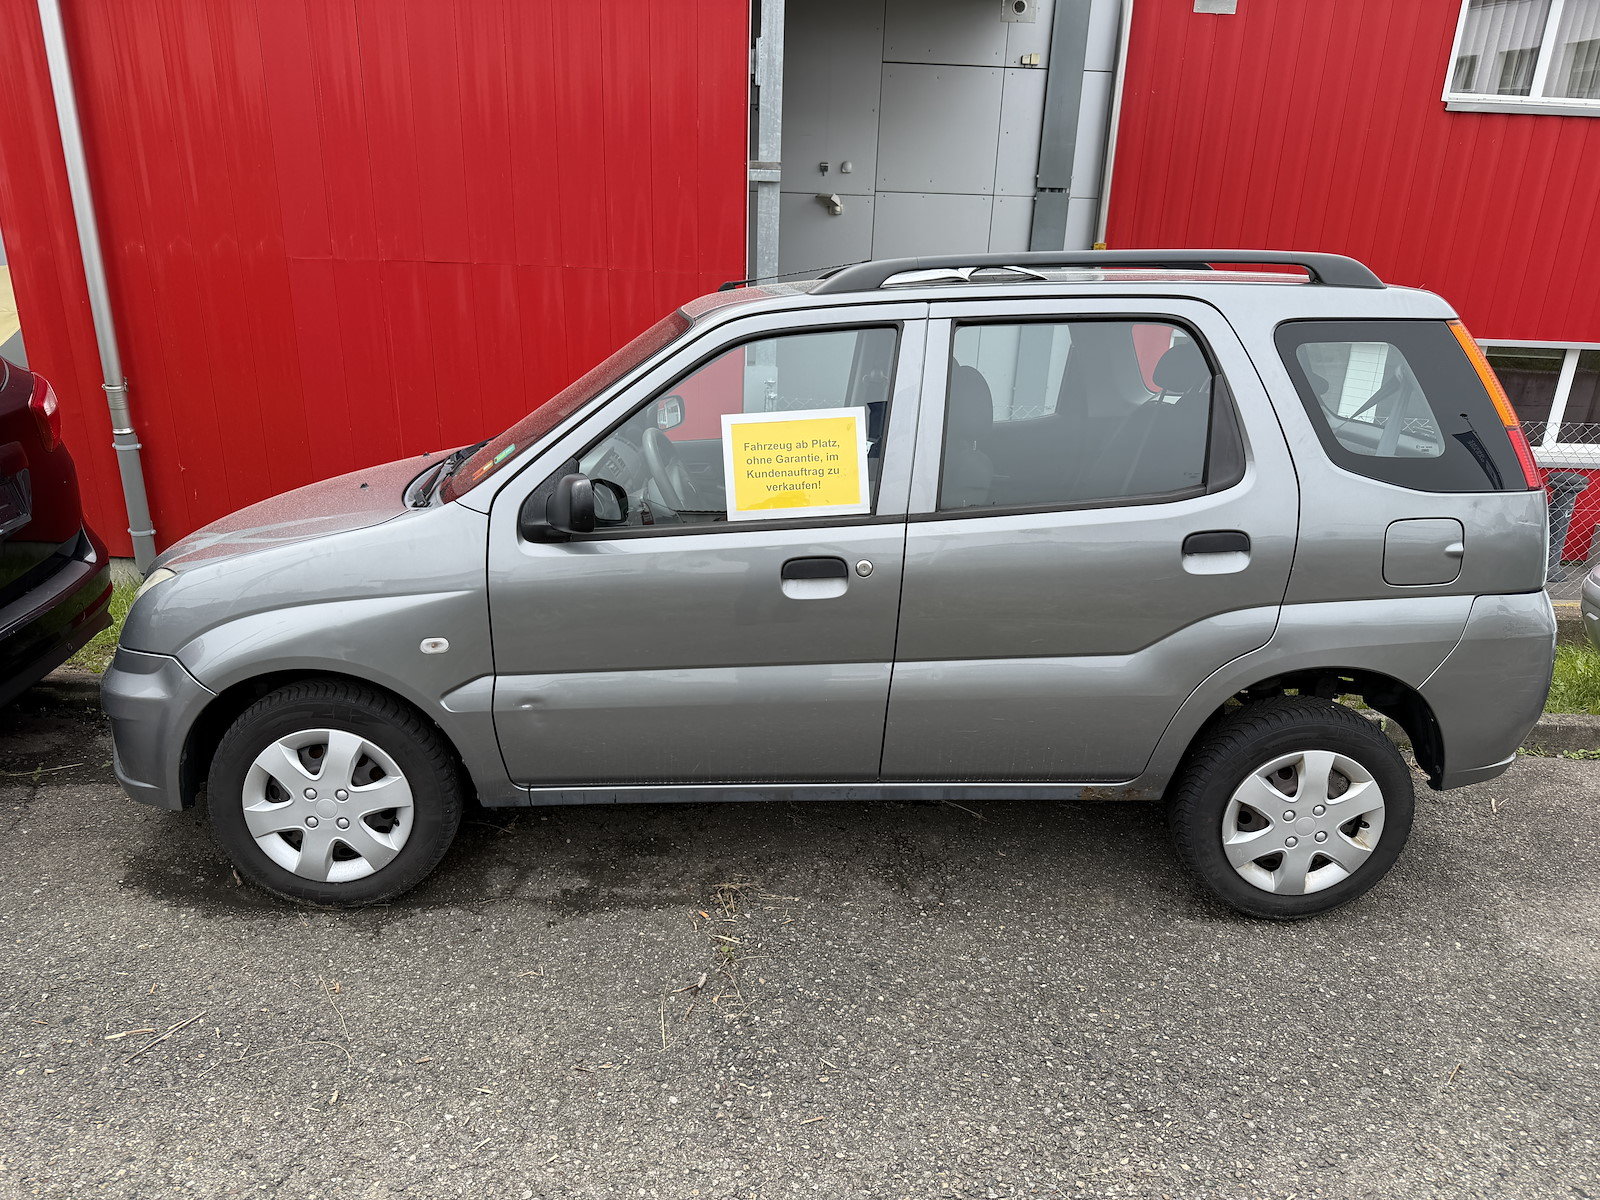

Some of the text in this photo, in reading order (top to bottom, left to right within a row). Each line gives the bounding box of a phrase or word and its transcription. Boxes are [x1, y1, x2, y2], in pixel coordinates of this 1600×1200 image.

[743, 439, 840, 452] Fahrzeug ab Platz,
[746, 452, 839, 465] ohne Garantie, im
[746, 468, 825, 479] Kundenauftrag
[766, 481, 821, 492] verkaufen!
